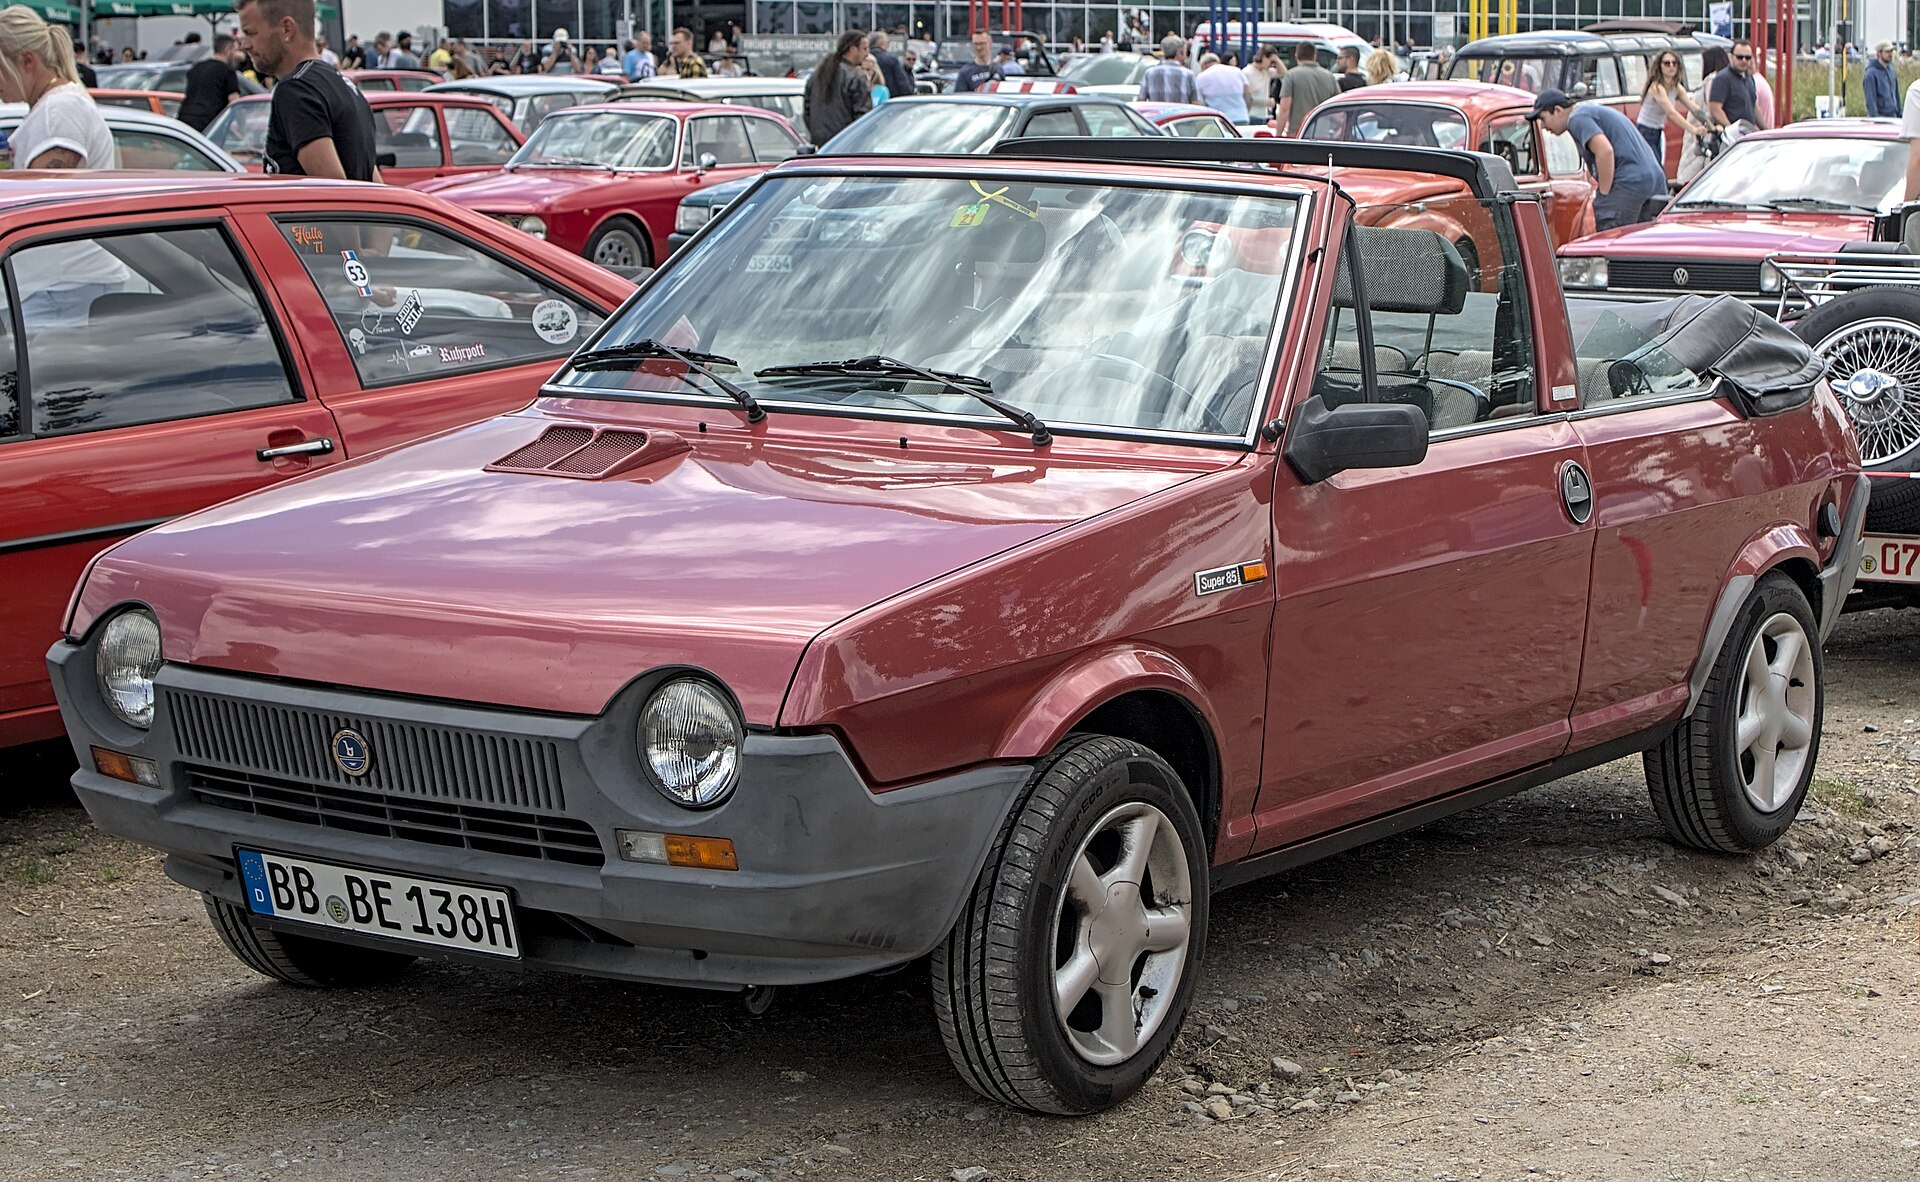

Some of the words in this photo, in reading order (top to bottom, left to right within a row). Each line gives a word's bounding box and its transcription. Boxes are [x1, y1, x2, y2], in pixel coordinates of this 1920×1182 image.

[960, 214, 976, 225] 21
[290, 225, 323, 246] Halle
[347, 265, 367, 281] 53
[395, 296, 416, 326] LEIDER
[401, 290, 424, 335] GEIL!
[438, 343, 486, 363] Ruhrpott
[1881, 542, 1920, 577] 07
[1201, 575, 1226, 590] Super
[1225, 569, 1237, 584] 85
[255, 888, 265, 903] D
[266, 861, 320, 915] BB
[344, 874, 402, 931] BE
[405, 885, 514, 949] 138H
